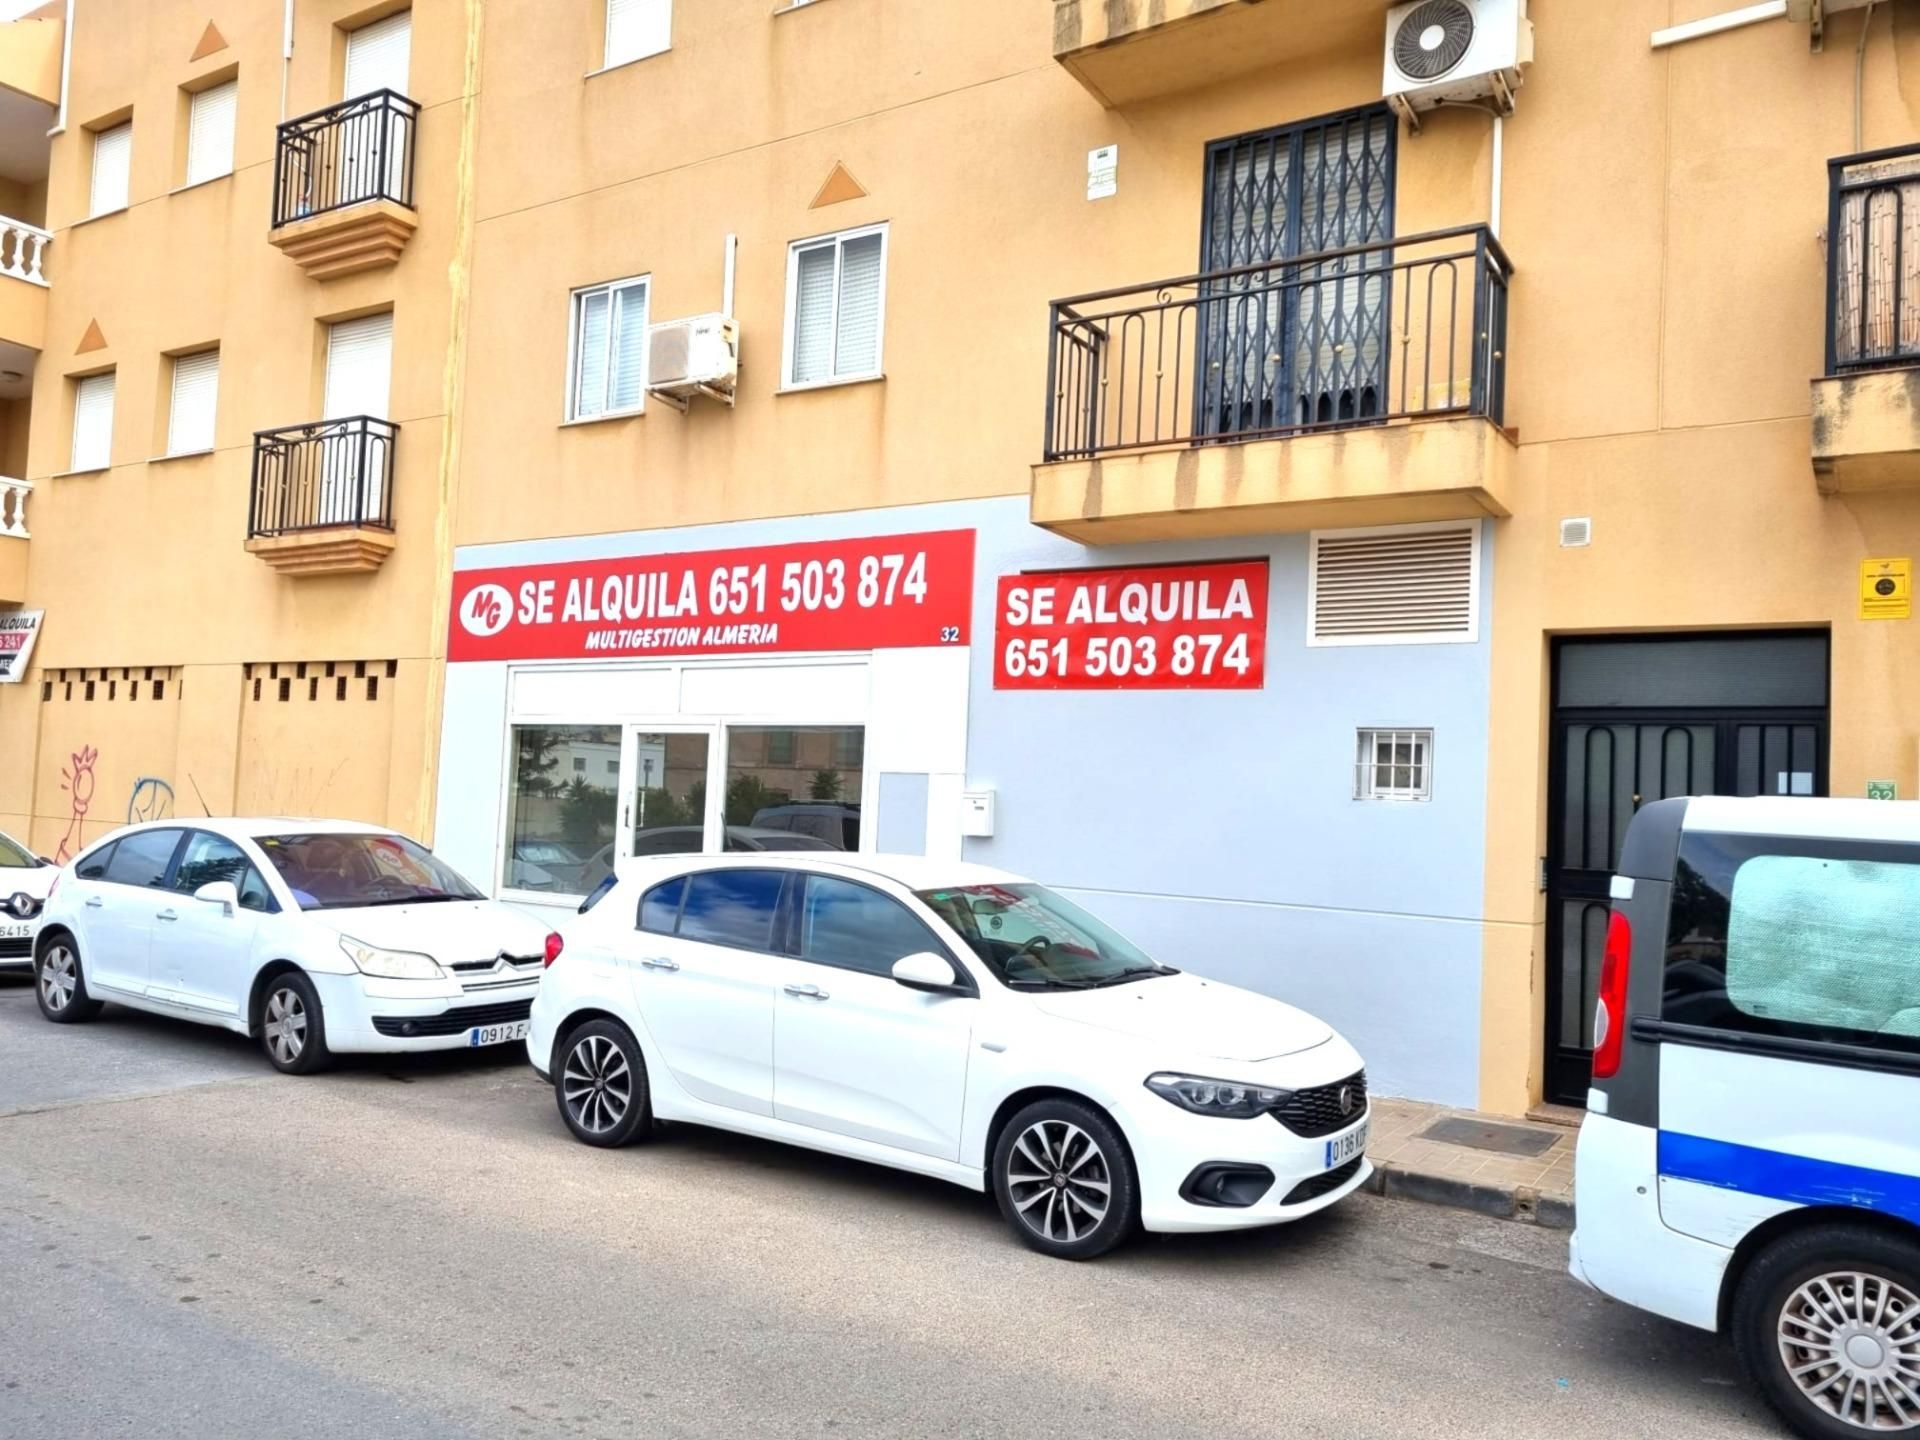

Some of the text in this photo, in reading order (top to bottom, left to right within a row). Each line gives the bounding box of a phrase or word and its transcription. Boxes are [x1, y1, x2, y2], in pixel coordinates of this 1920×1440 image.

[517, 551, 928, 625] SE ALQUILA 651 503 874
[1006, 578, 1254, 626] SE ALQUILA
[472, 590, 501, 629] MG
[584, 623, 779, 650] MULTIGESTION ALMERIA
[941, 626, 960, 642] 32
[1004, 632, 1250, 677] 651 503 874
[0, 925, 30, 937] 6415
[481, 1025, 514, 1044] 0912
[1333, 1133, 1354, 1161] 0136
